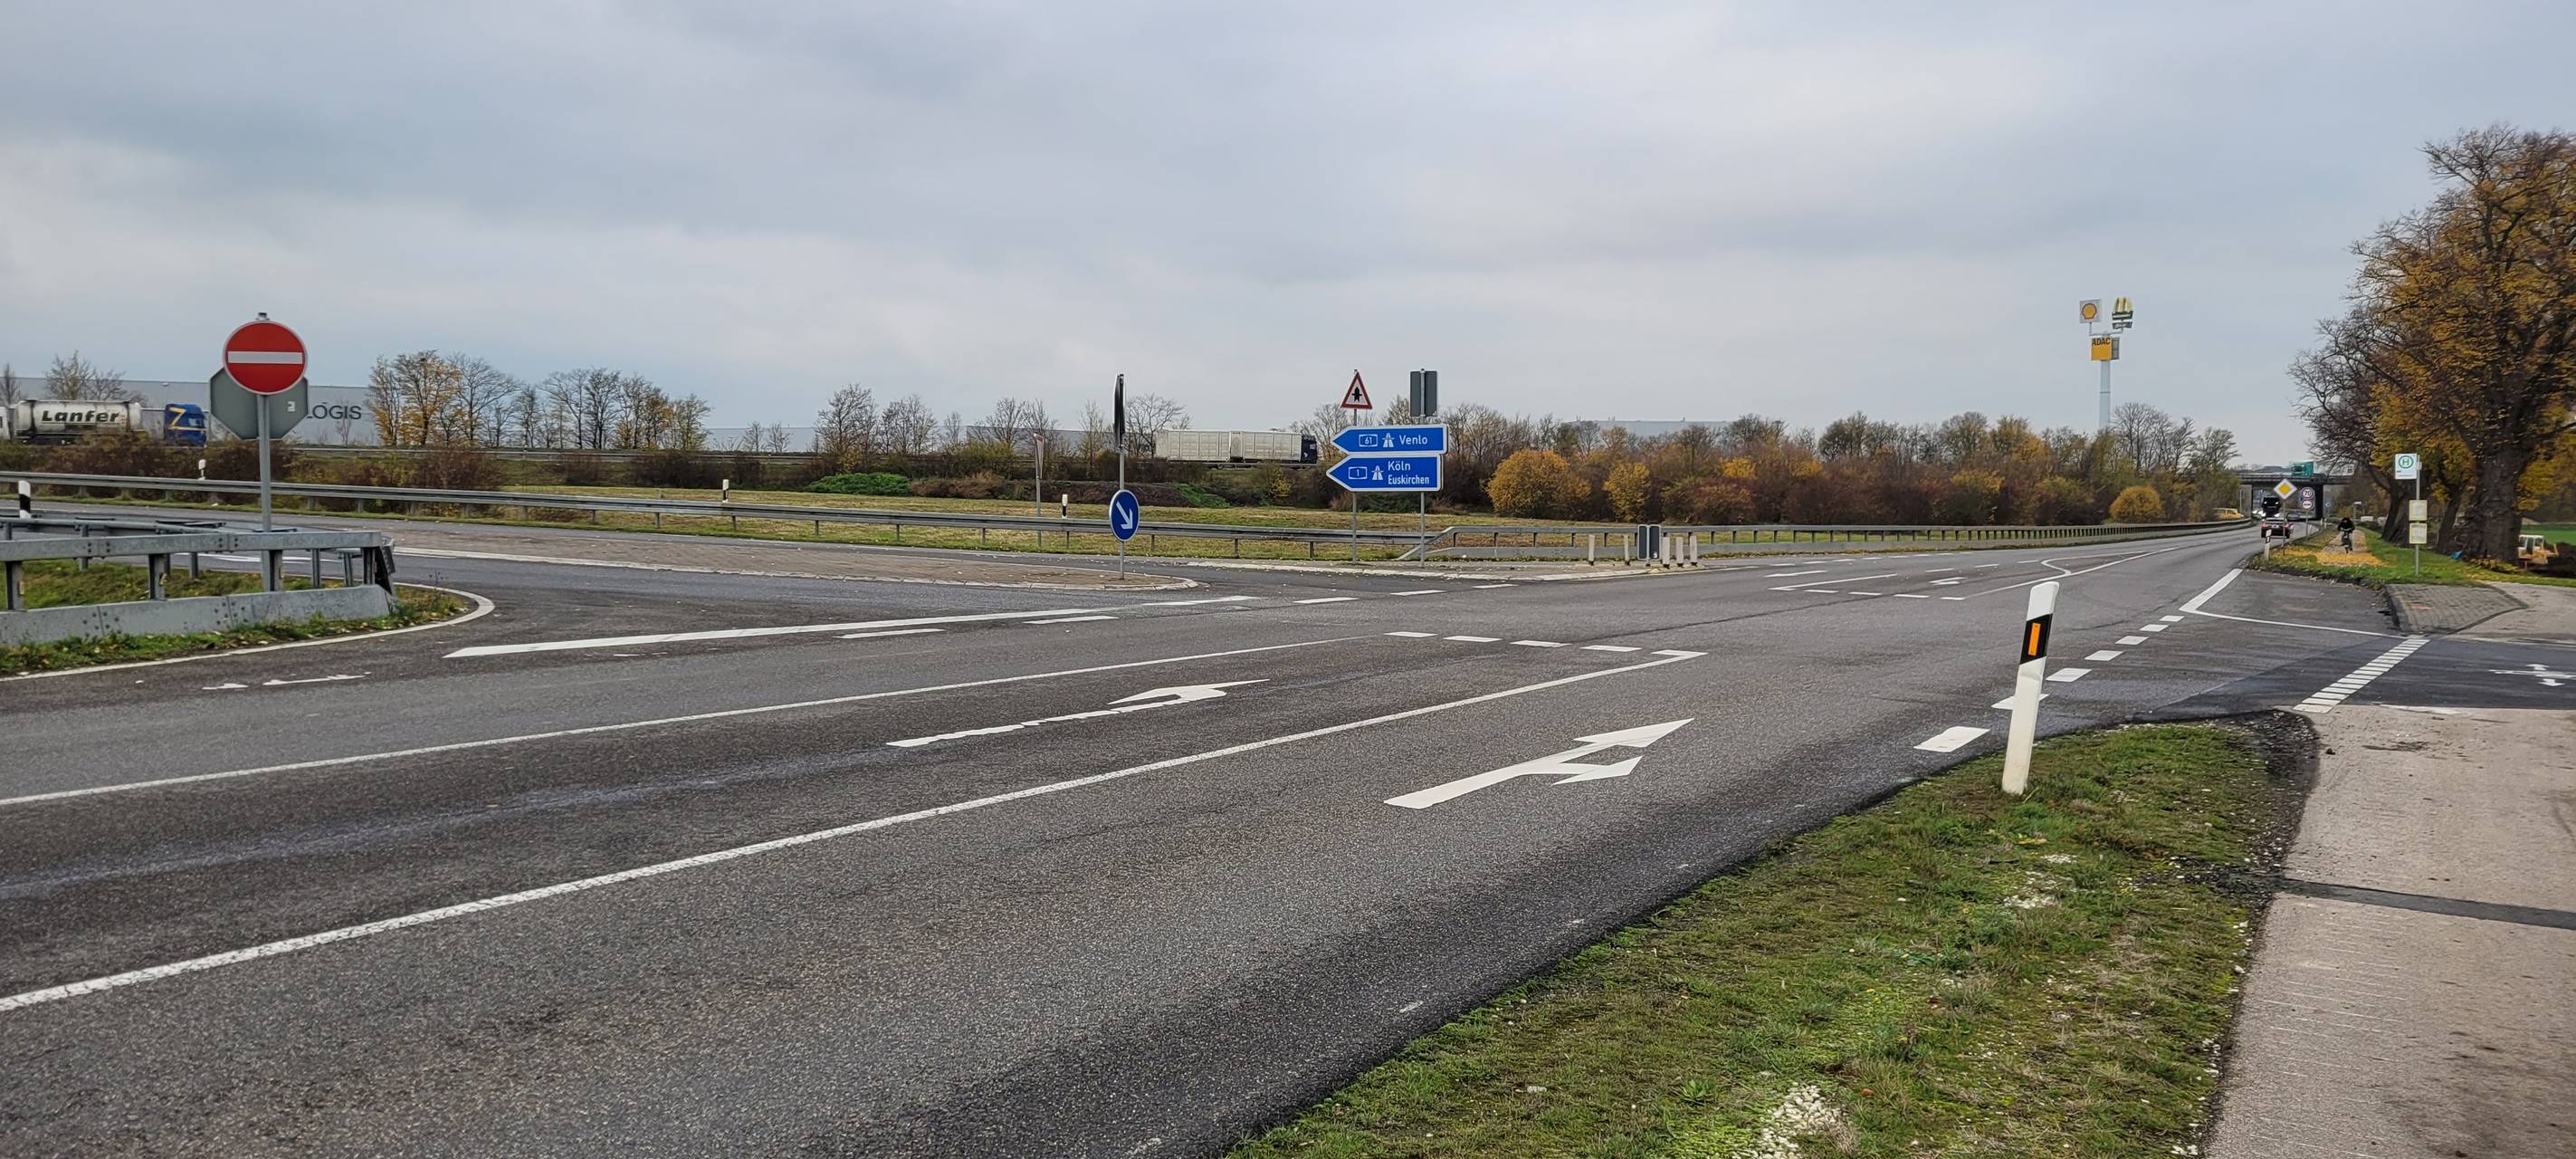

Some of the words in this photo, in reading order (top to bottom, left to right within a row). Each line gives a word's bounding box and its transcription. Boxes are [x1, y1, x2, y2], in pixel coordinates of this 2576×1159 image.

[2092, 337, 2111, 346] ADAC
[42, 410, 119, 423] Lanfer
[1399, 435, 1428, 445] Venlo
[1388, 460, 1411, 471] Köln
[1388, 474, 1430, 485] Euskirchen
